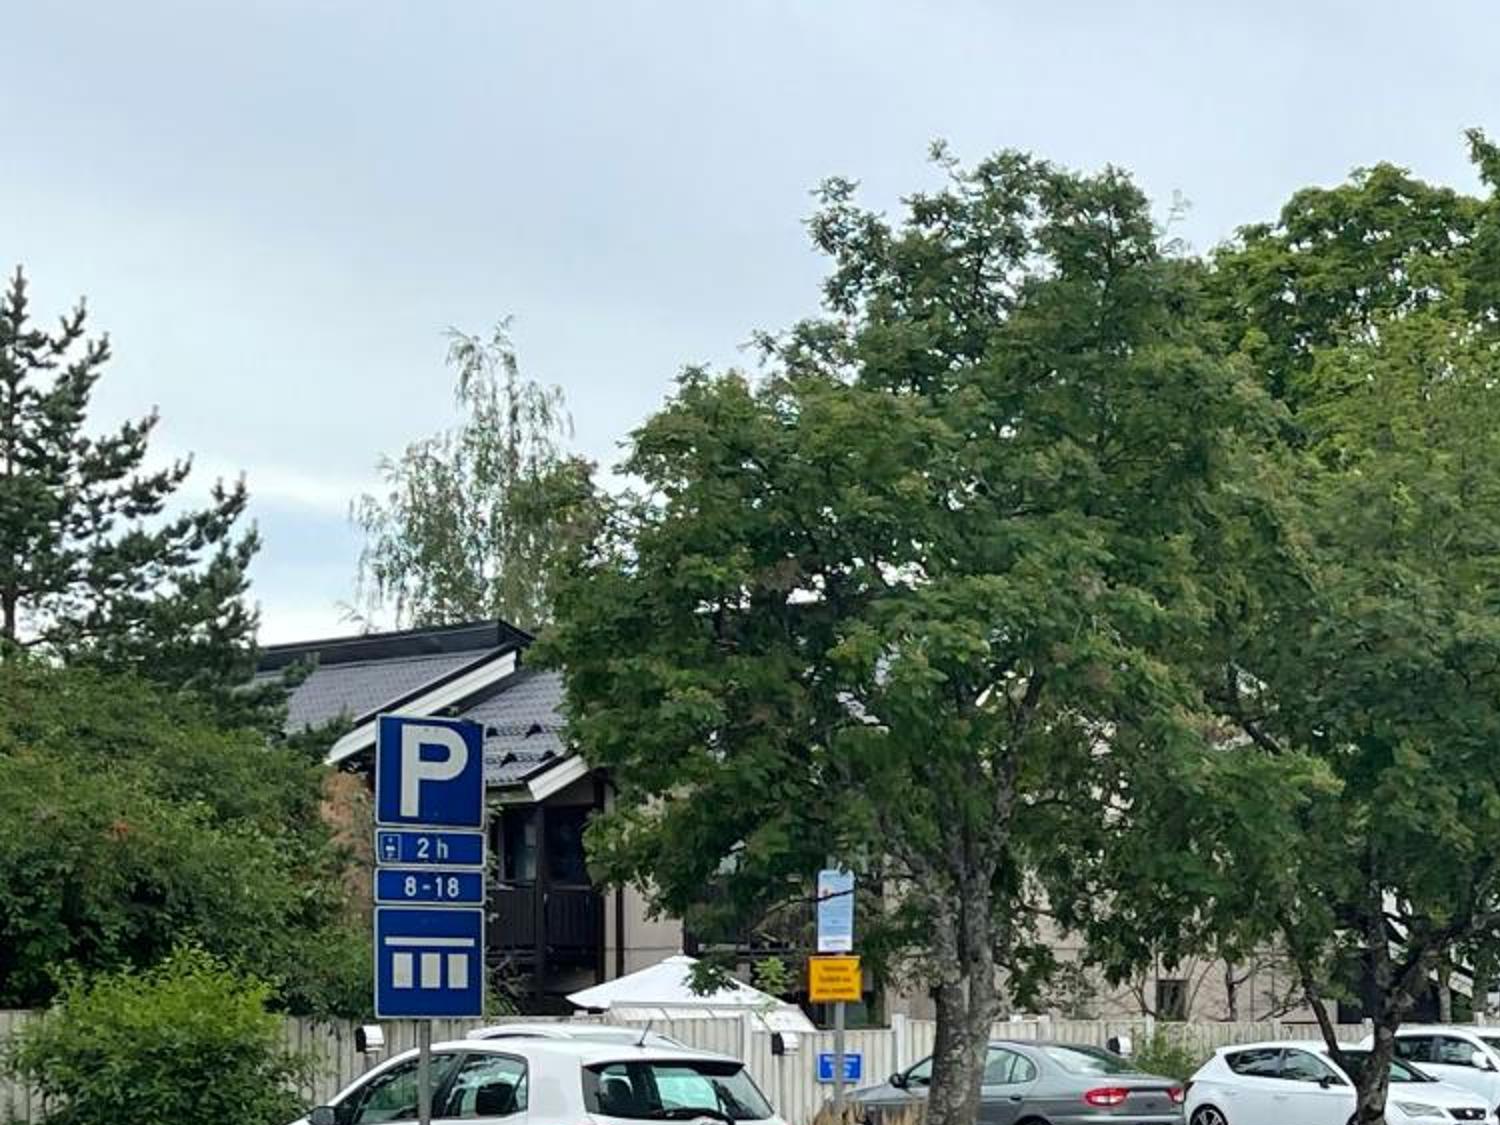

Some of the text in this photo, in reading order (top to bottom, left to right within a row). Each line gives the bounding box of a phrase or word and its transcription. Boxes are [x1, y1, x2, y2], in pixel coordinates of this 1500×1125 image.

[401, 724, 468, 817] P
[417, 838, 448, 859] 2 h
[404, 876, 459, 898] 8-18
